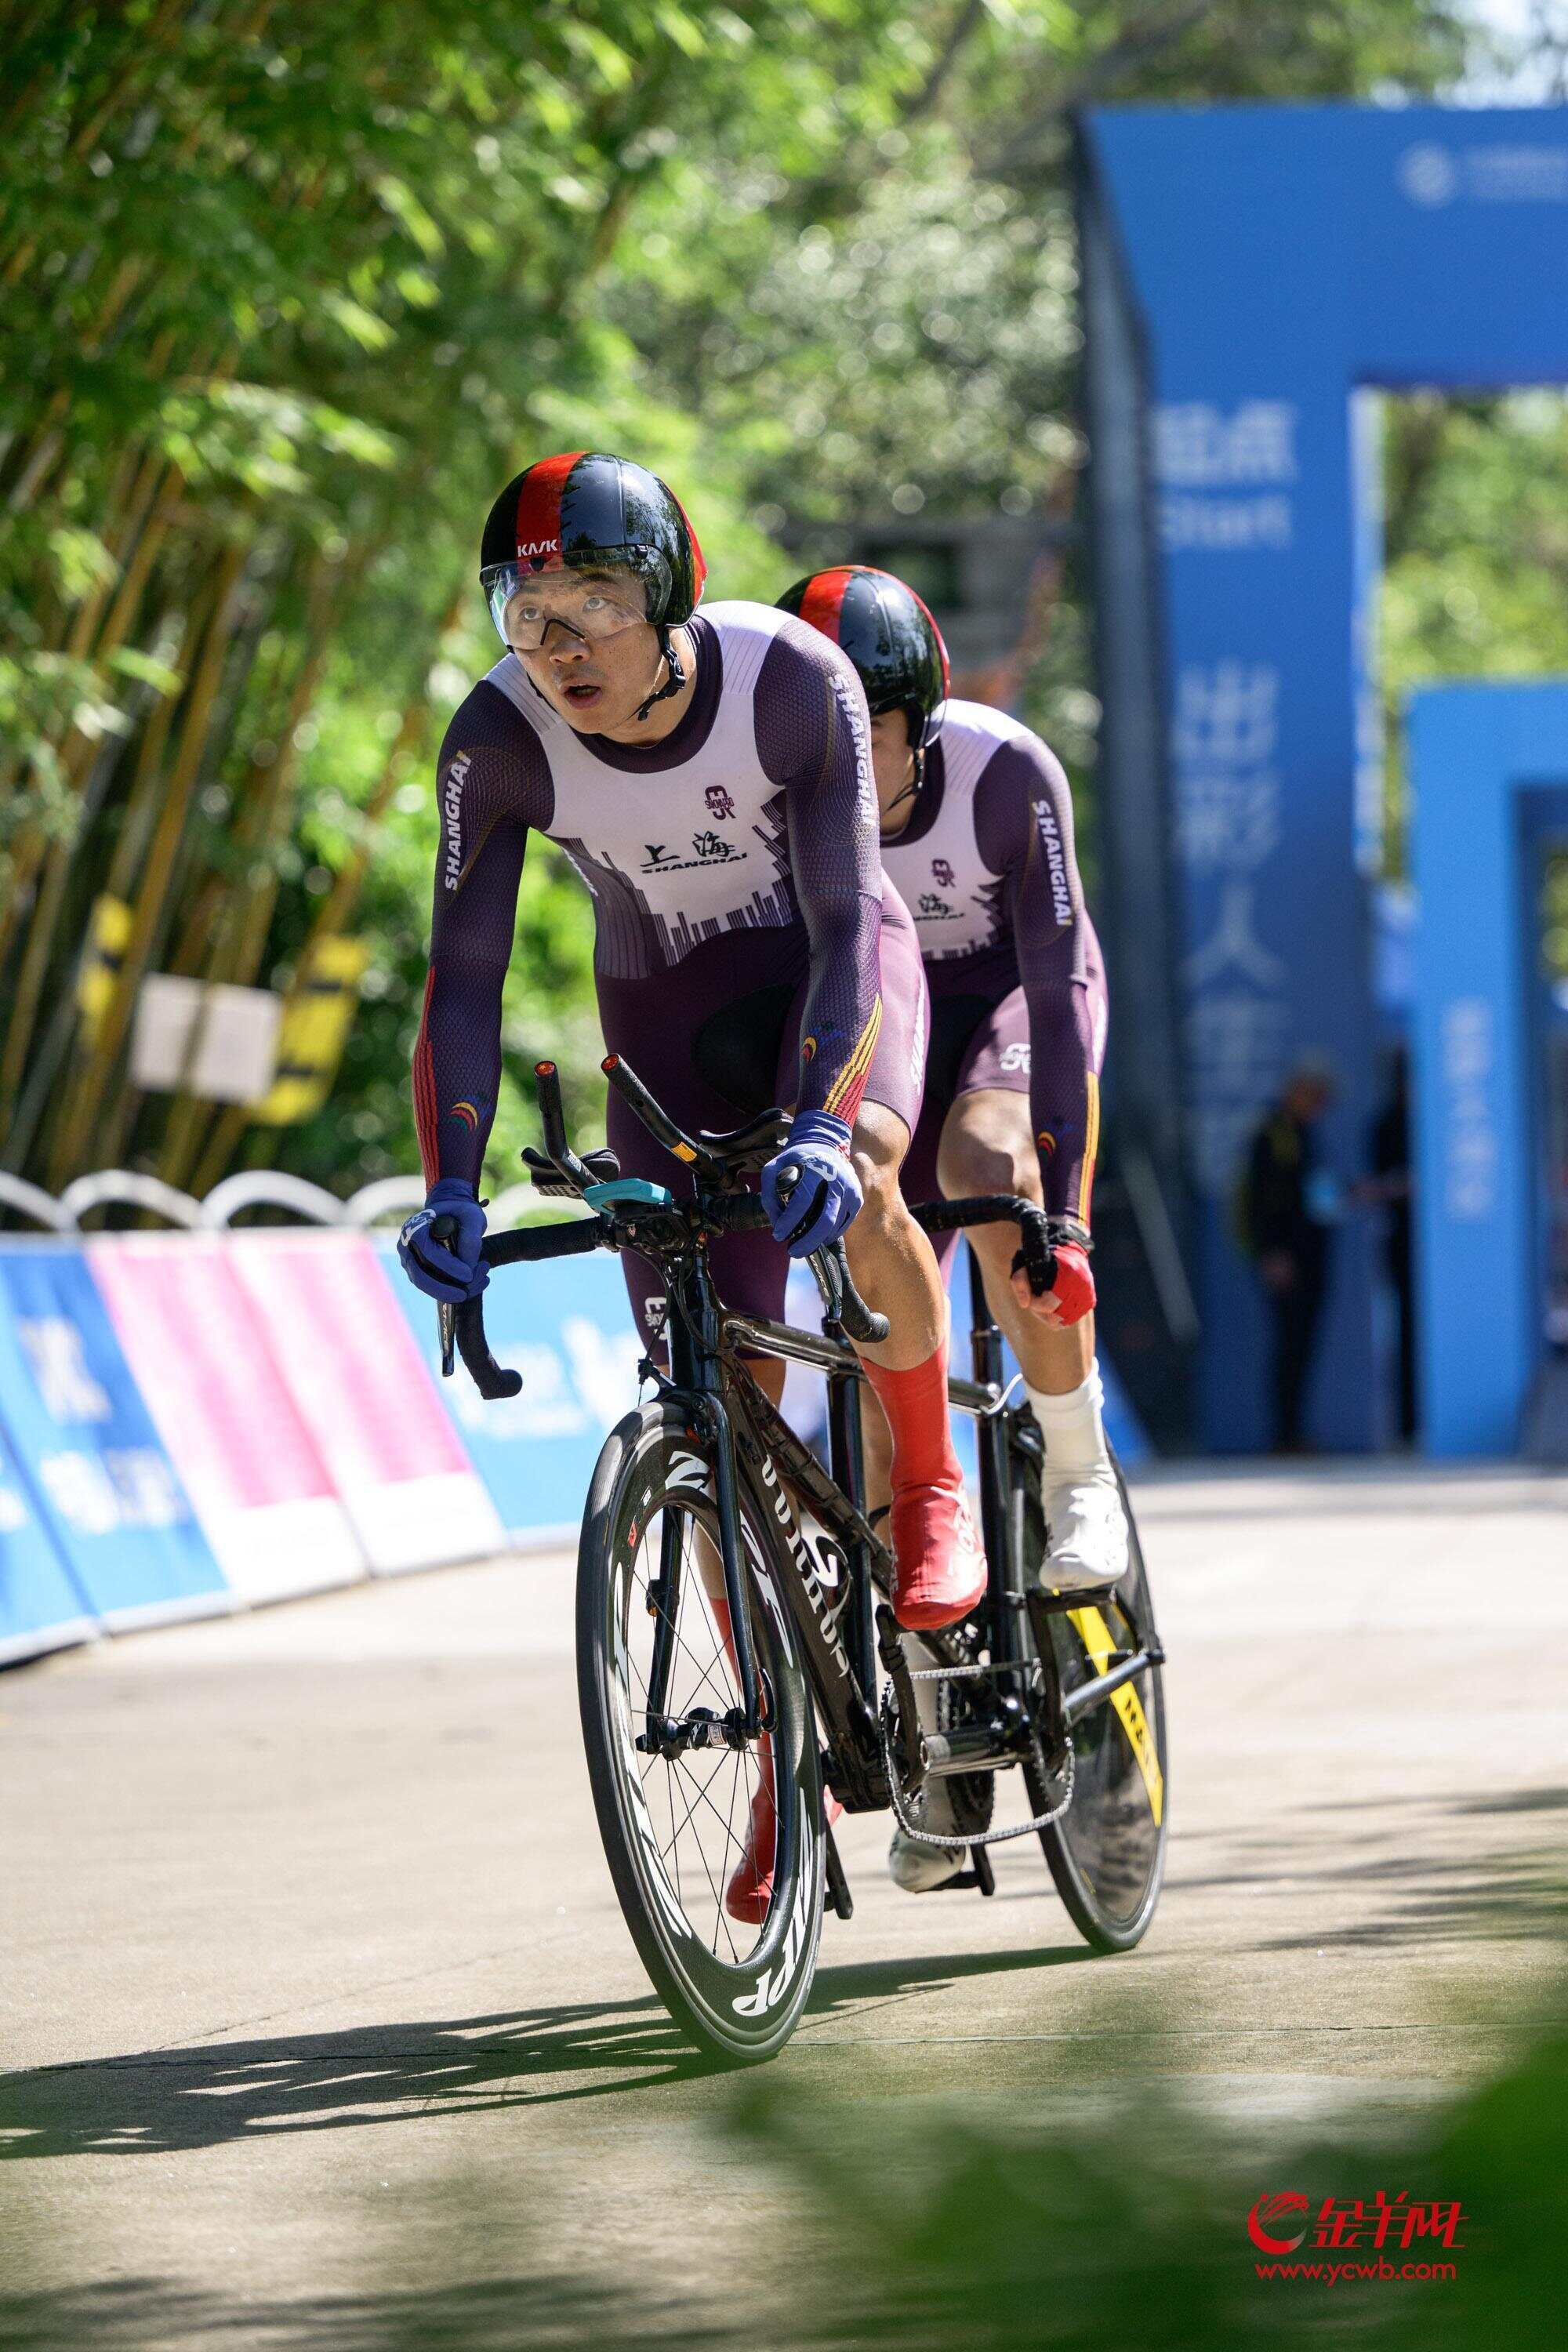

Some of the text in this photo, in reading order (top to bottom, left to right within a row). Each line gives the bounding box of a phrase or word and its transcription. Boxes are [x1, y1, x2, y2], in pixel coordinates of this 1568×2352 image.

[517, 539, 558, 557] KASK
[829, 673, 876, 826] SHANGHAI
[445, 750, 471, 891] SHANGHAI
[640, 830, 735, 867] 上海
[641, 852, 747, 874] SHANGHAI
[1032, 800, 1073, 926] SHANGHAI
[732, 1787, 814, 2017] ZIPP
